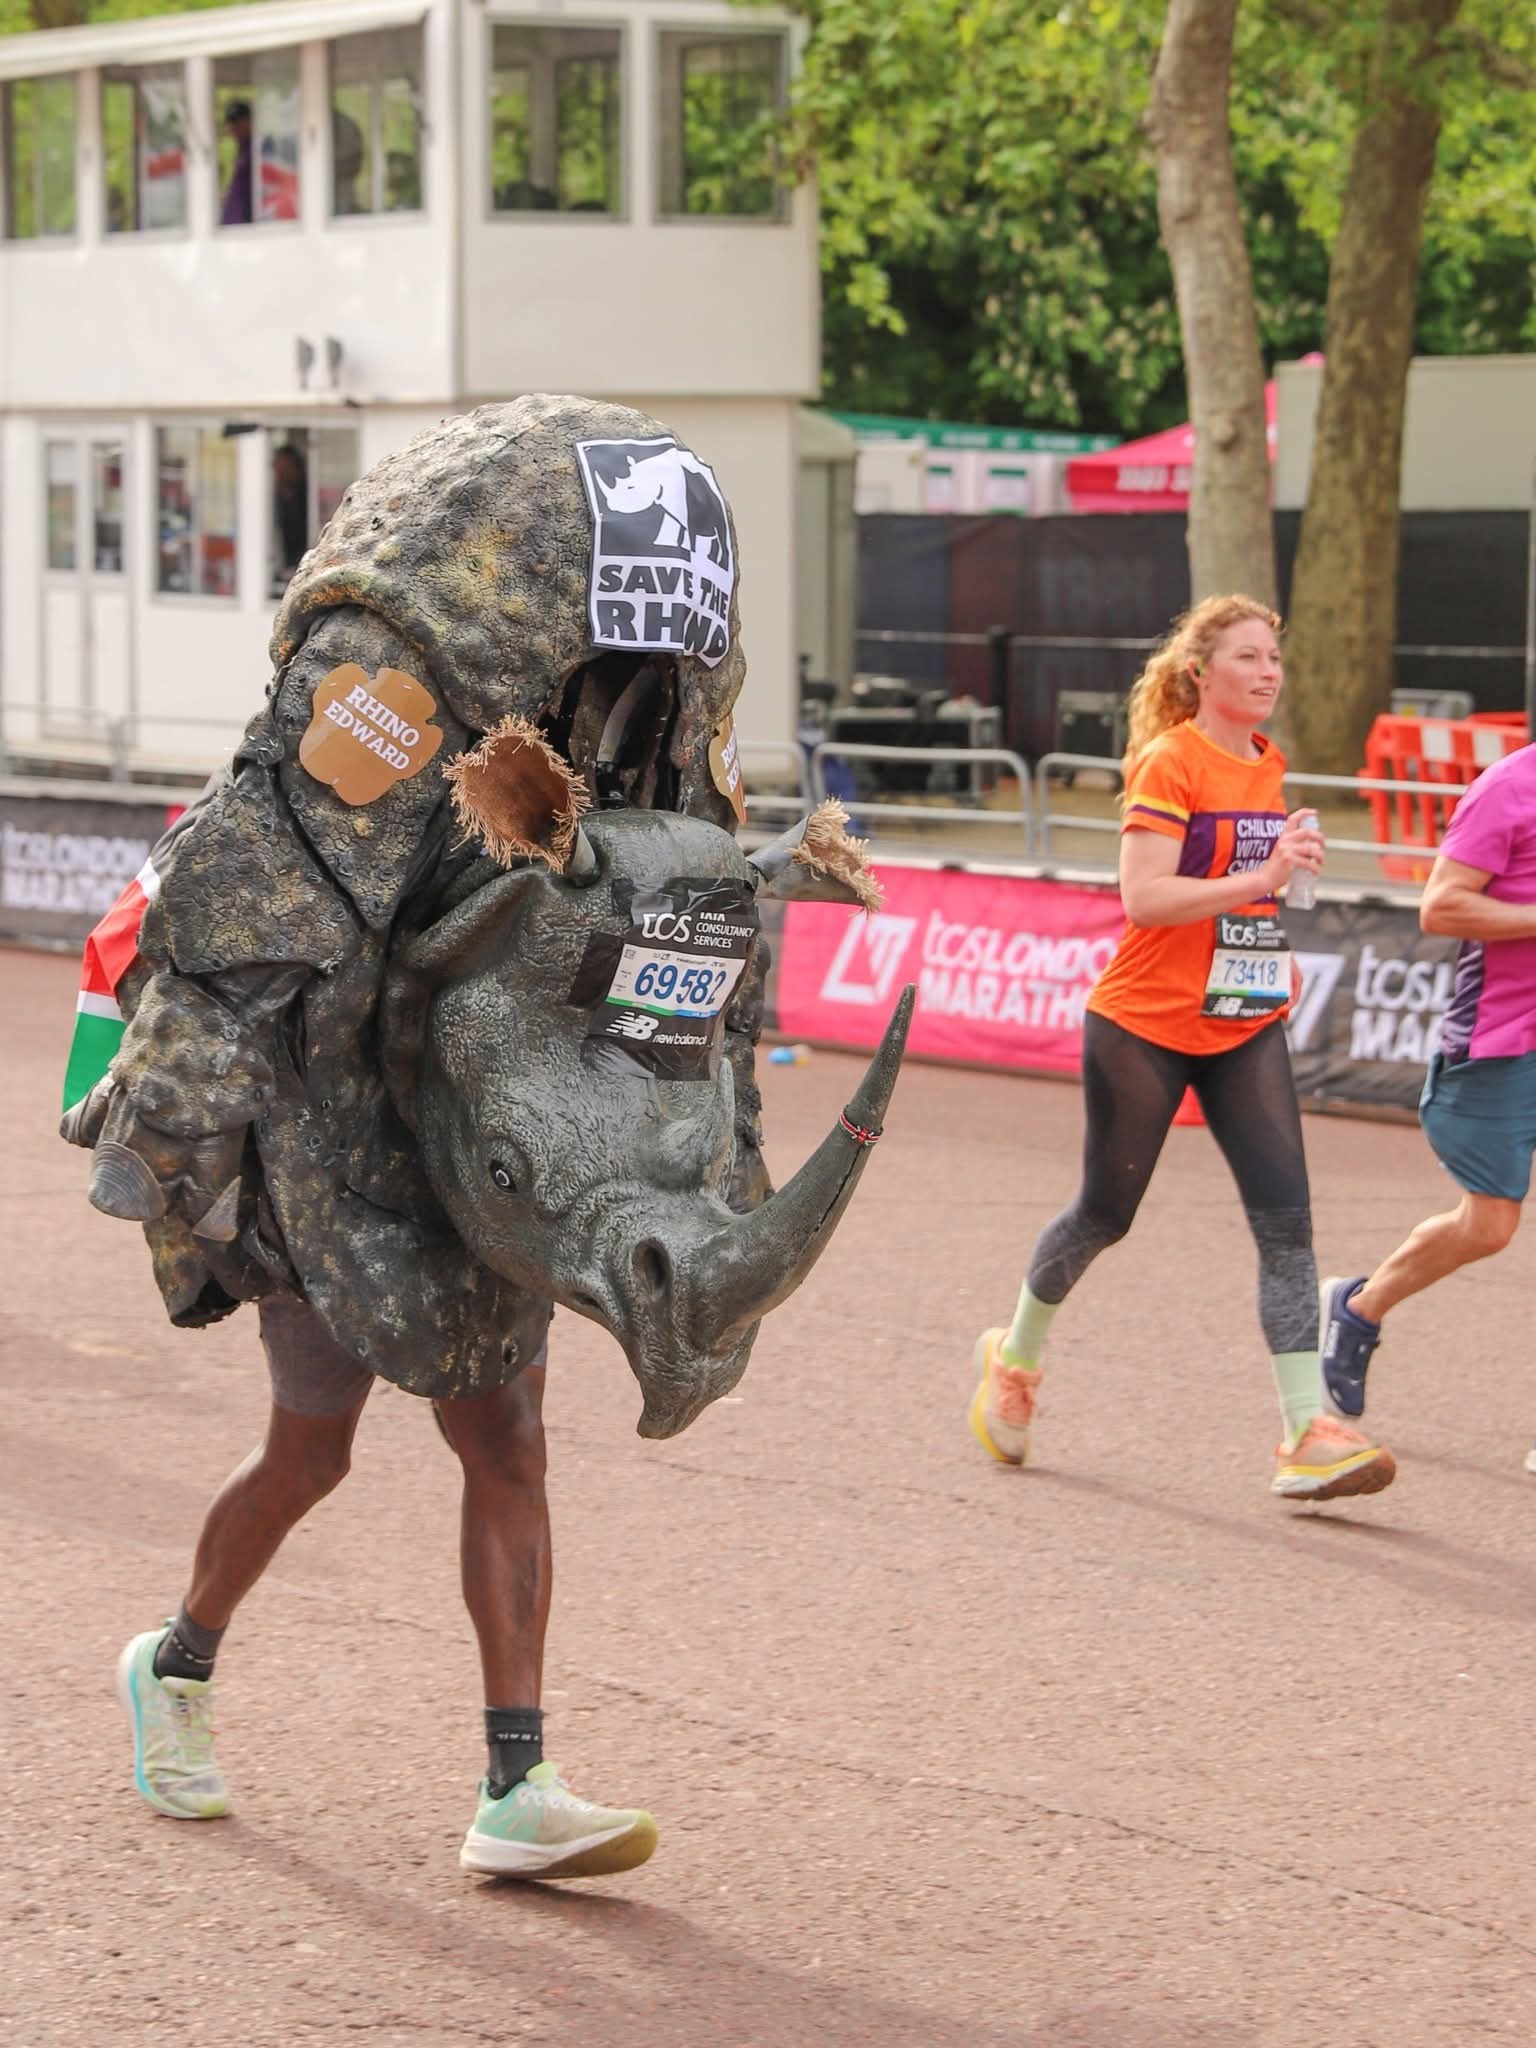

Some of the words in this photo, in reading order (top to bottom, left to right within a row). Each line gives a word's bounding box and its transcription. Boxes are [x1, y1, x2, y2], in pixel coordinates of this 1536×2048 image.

[597, 564, 693, 600] SAVE
[700, 577, 729, 621] THE
[345, 684, 420, 747] RHINO
[323, 700, 410, 770] EDWARD
[1236, 839, 1271, 859] WITH
[641, 913, 692, 943] tcs
[692, 935, 733, 949] SERVICES
[695, 922, 754, 938] CONSULTANCY
[1221, 918, 1257, 947] tcs
[634, 962, 727, 1006] 69582
[1223, 959, 1278, 986] 73418
